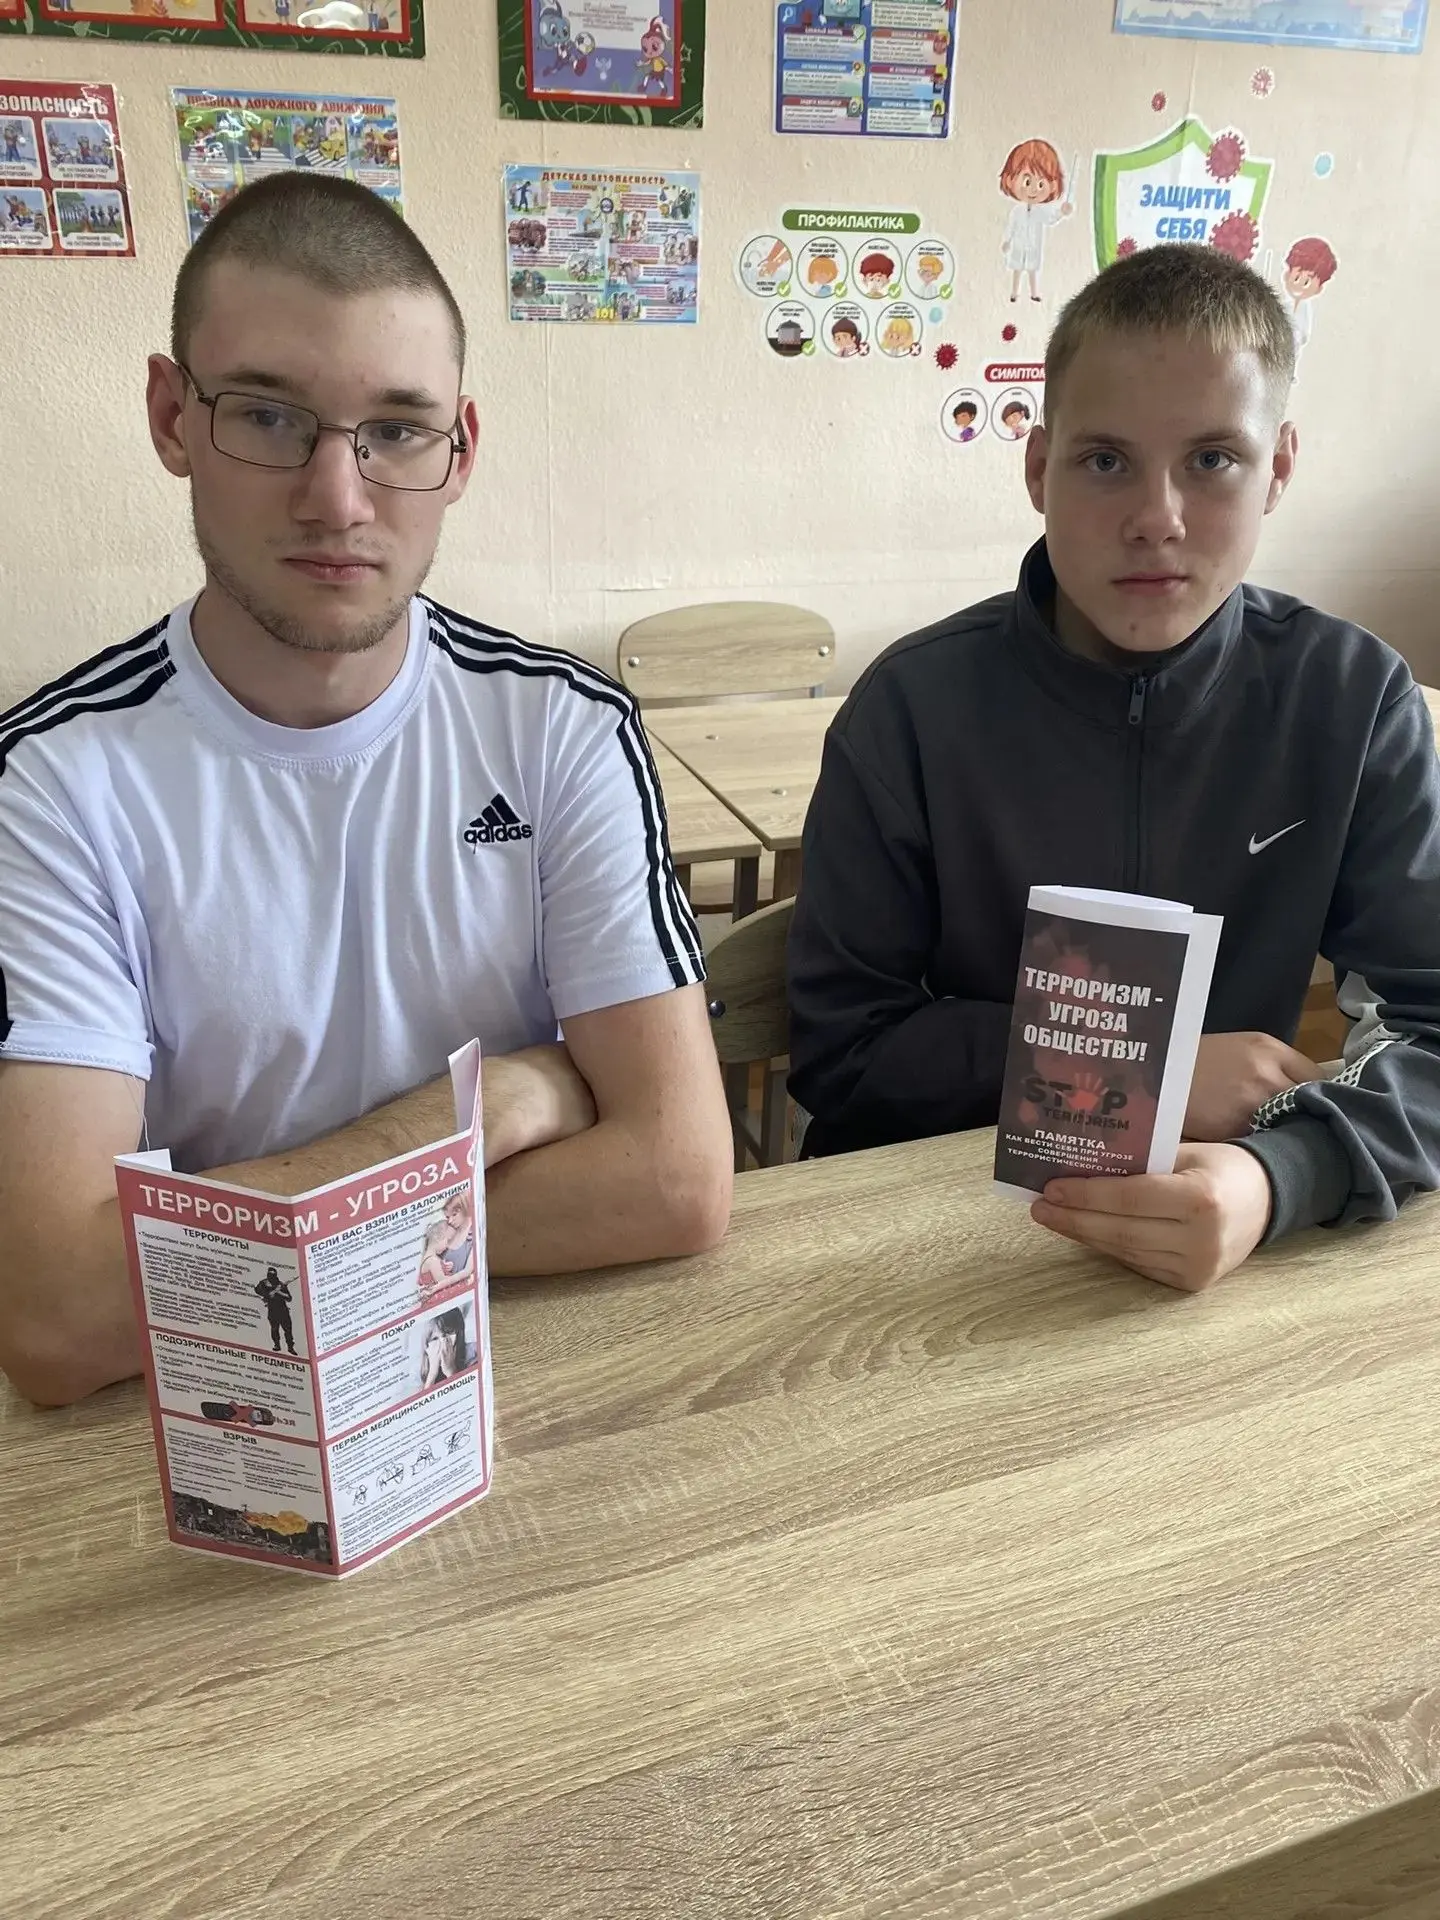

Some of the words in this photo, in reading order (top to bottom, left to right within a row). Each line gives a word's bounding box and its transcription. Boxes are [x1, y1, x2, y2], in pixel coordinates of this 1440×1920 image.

[246, 97, 317, 112] ДОРОЖНОГО
[542, 171, 588, 182] ДЕТСКАЯ
[1140, 184, 1231, 211] ЗАЩИТИ
[797, 213, 905, 230] ПРОФИЛАКТИКА
[1155, 217, 1208, 240] СЕБЯ
[463, 822, 533, 844] adidas
[1025, 966, 1151, 1007] ТЕРРОРИЗМ
[1048, 1001, 1128, 1033] УГРОЗА
[1023, 1024, 1148, 1062] ОБЩЕСТВУ!
[1005, 1133, 1023, 1143] КАК
[1025, 1138, 1053, 1148] ВЕСТИ
[1055, 1142, 1078, 1152] СЕБЯ
[1080, 1147, 1098, 1156] ПРИ
[1101, 1151, 1133, 1161] УГРОЗЕ
[1035, 1129, 1106, 1150] ПАМЯТКА
[1008, 1148, 1103, 1171] ТЕРРОРИСТИЧЕСКОГО
[1105, 1166, 1128, 1175] АКТА
[1038, 1147, 1099, 1163] СОВЕРШЕНИЯ
[139, 1183, 318, 1239] ТЕРРОРИЗМ
[346, 1156, 459, 1218] УГРОЗА
[310, 1235, 340, 1253] ЕСЛИ
[342, 1226, 362, 1241] ВАС
[365, 1211, 399, 1232] ВЗЯЛИ
[401, 1207, 408, 1217] В
[410, 1181, 469, 1213] ЗАЛОЖНИКИ
[183, 1228, 249, 1251] ТЕРРОРИСТЫ
[381, 1319, 416, 1341] ПОЖАР
[156, 1332, 247, 1361] ПОДОЗРИТЕЛЬНЫЕ
[251, 1354, 306, 1373] ПРЕДМЕТЫ
[332, 1428, 369, 1452] ПЕРВАЯ
[370, 1395, 436, 1434] МЕДИЦИНСКАЯ
[437, 1374, 476, 1398] ПОМОЩЬ
[223, 1431, 257, 1445] ВЗРЫВ
